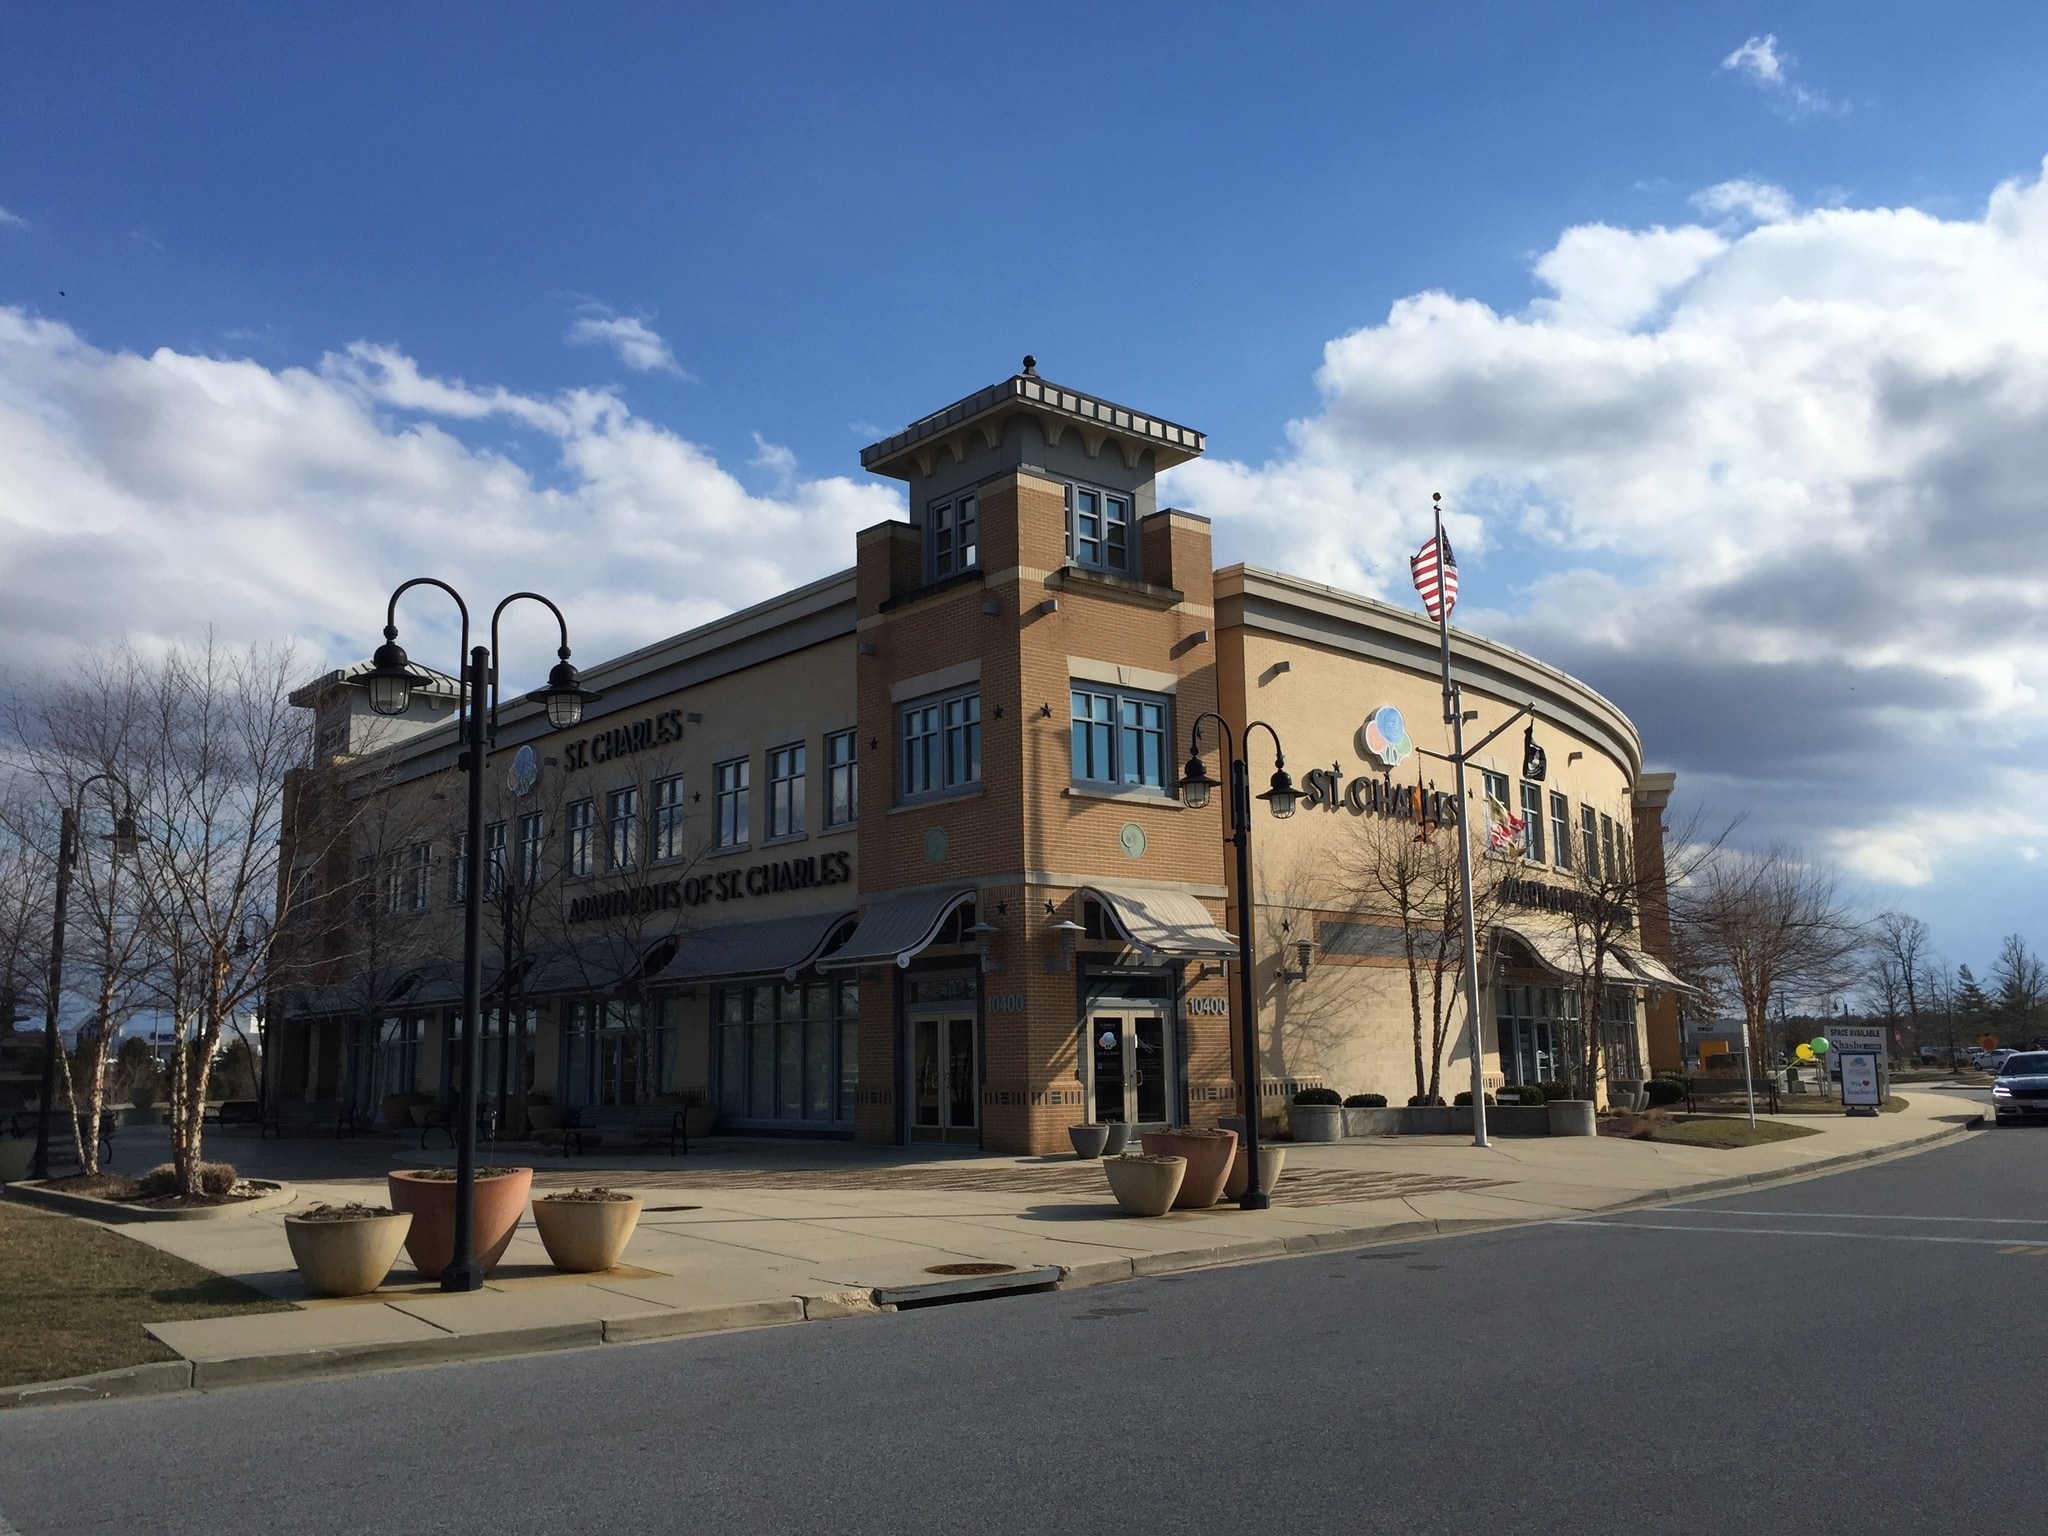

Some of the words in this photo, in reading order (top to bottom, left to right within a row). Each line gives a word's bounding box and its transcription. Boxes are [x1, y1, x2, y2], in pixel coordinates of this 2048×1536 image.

[563, 739, 589, 772] ST.
[590, 709, 682, 763] CHARLES
[1308, 769, 1346, 807] ST.
[684, 874, 713, 906] OF
[715, 870, 744, 901] ST.
[745, 851, 851, 897] CHARLES
[988, 994, 1025, 1012] 10400
[1188, 997, 1228, 1016] 10400
[1830, 1028, 1849, 1037] SPACE
[1850, 1029, 1881, 1038] AVAILABLE
